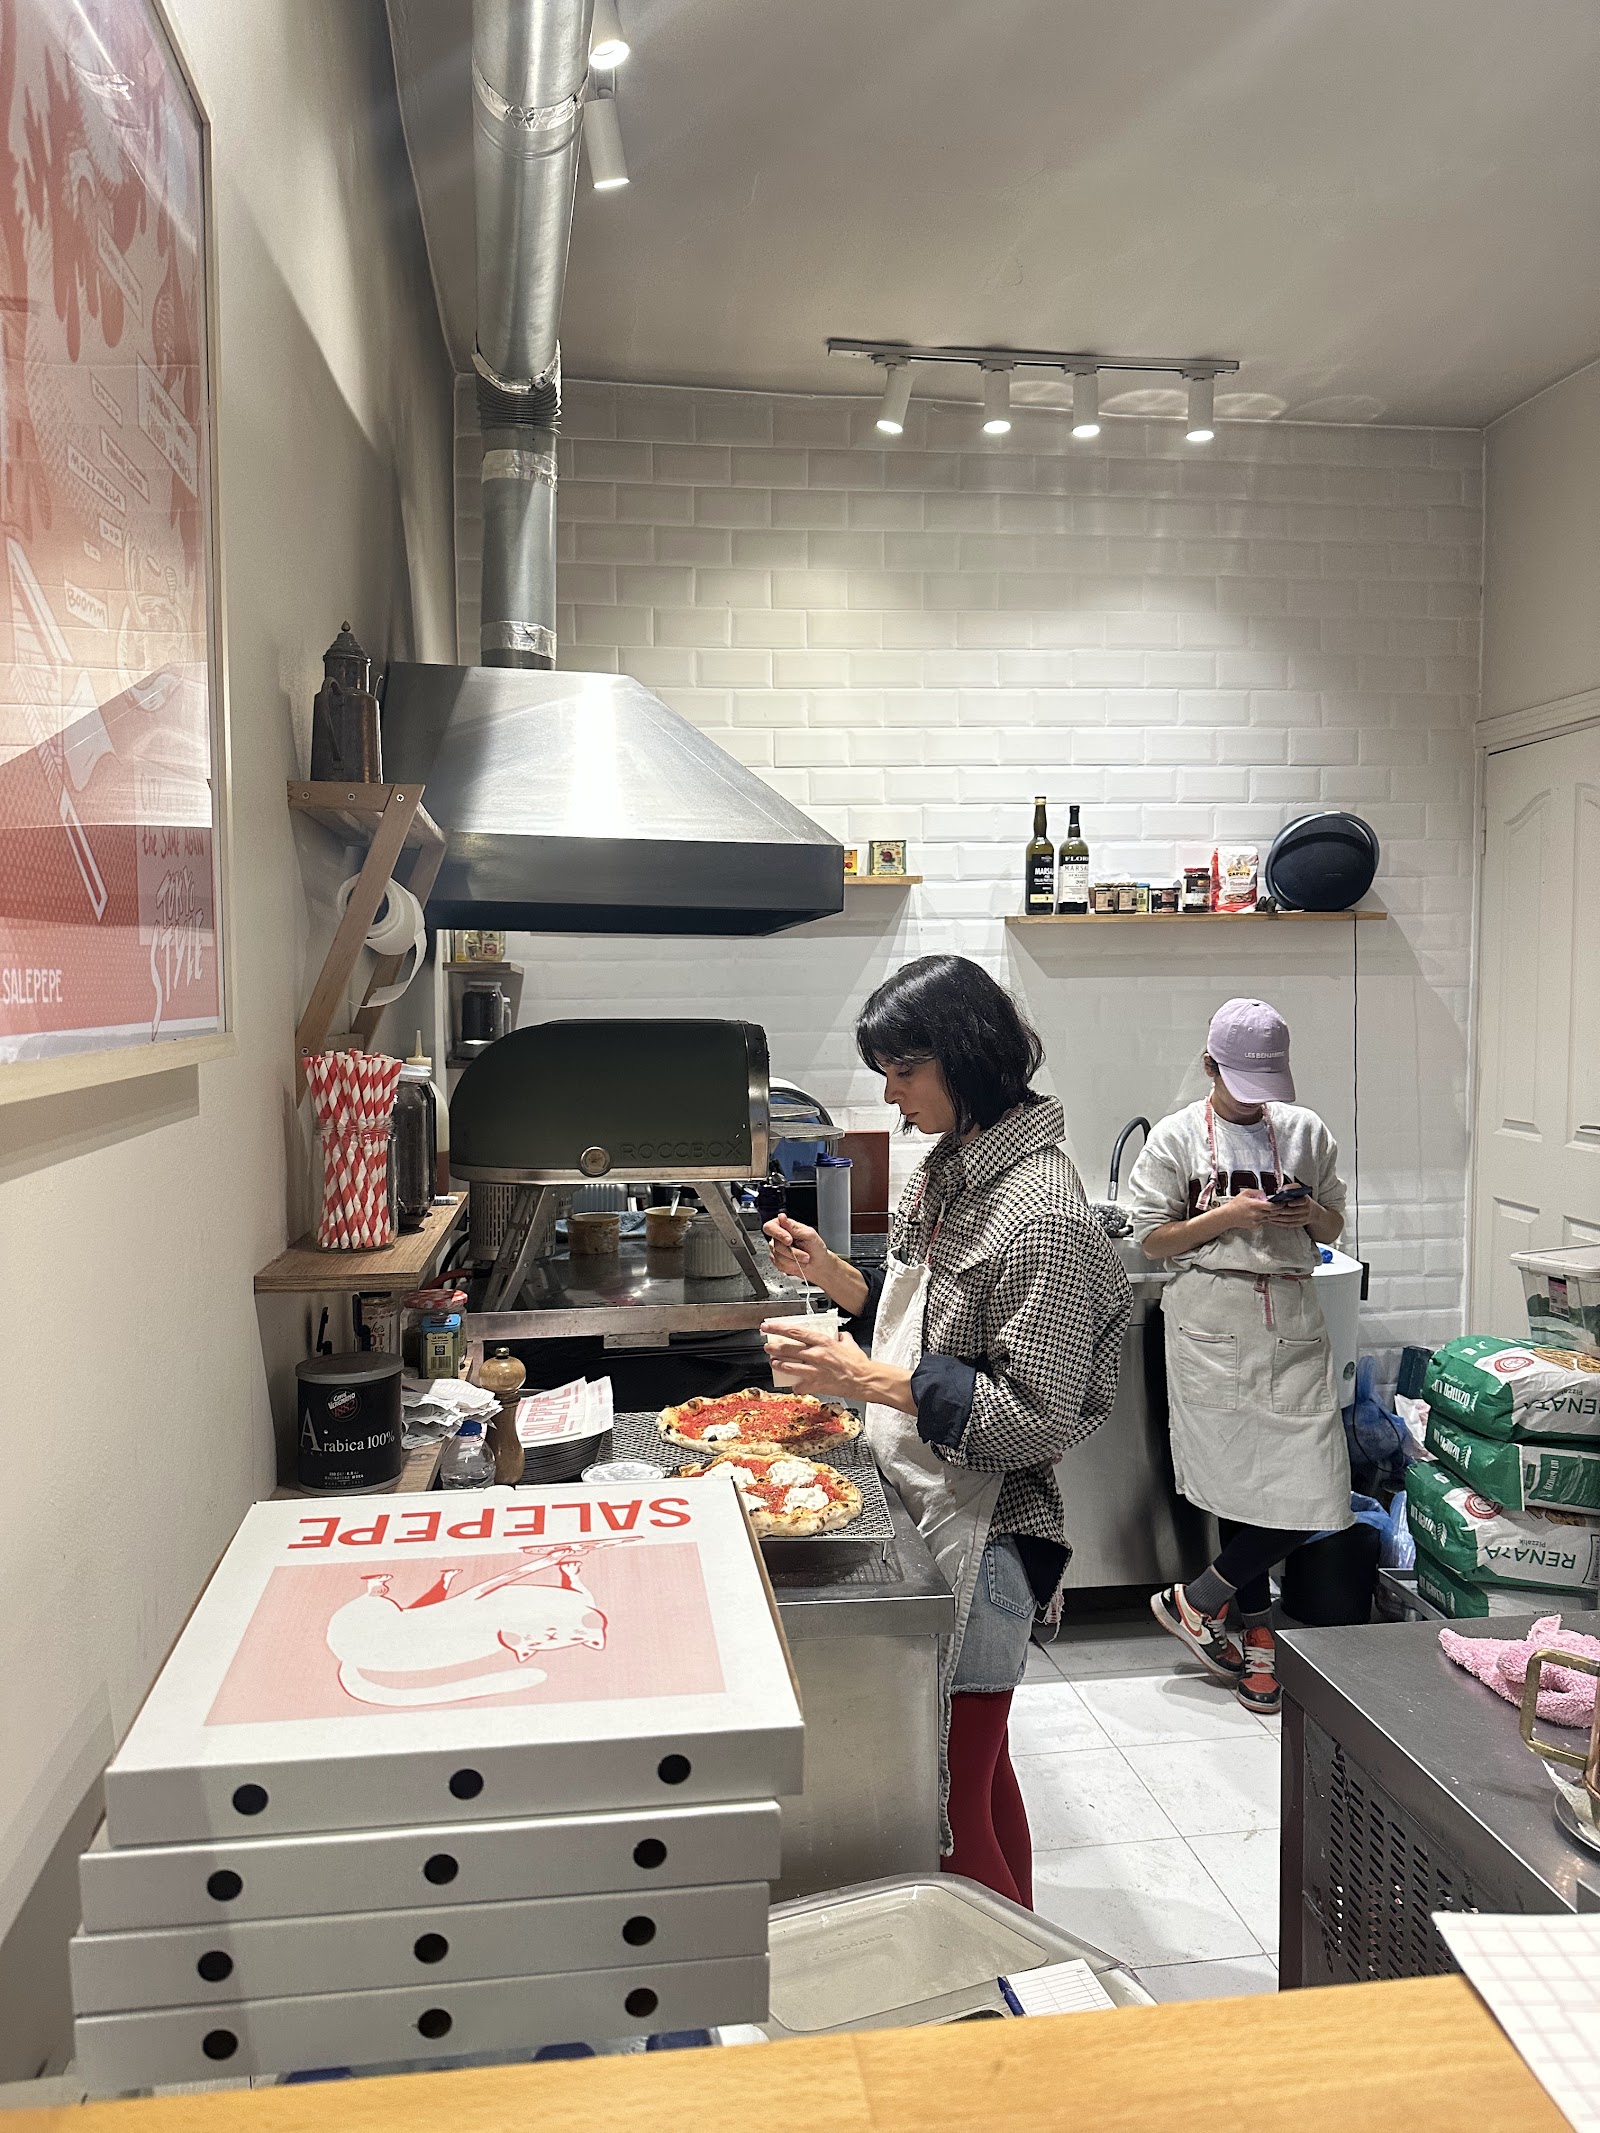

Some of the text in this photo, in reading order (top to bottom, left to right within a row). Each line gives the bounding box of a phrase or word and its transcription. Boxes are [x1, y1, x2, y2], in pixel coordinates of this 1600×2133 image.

[156, 865, 195, 928] TOKYO
[2, 967, 63, 1005] SALEPEPE
[151, 908, 204, 1042] STYLE
[620, 1140, 744, 1160] ROCCBOX
[300, 1407, 365, 1452] Arabica
[367, 1430, 396, 1450] 100%
[288, 1497, 692, 1549] SALEPEPE
